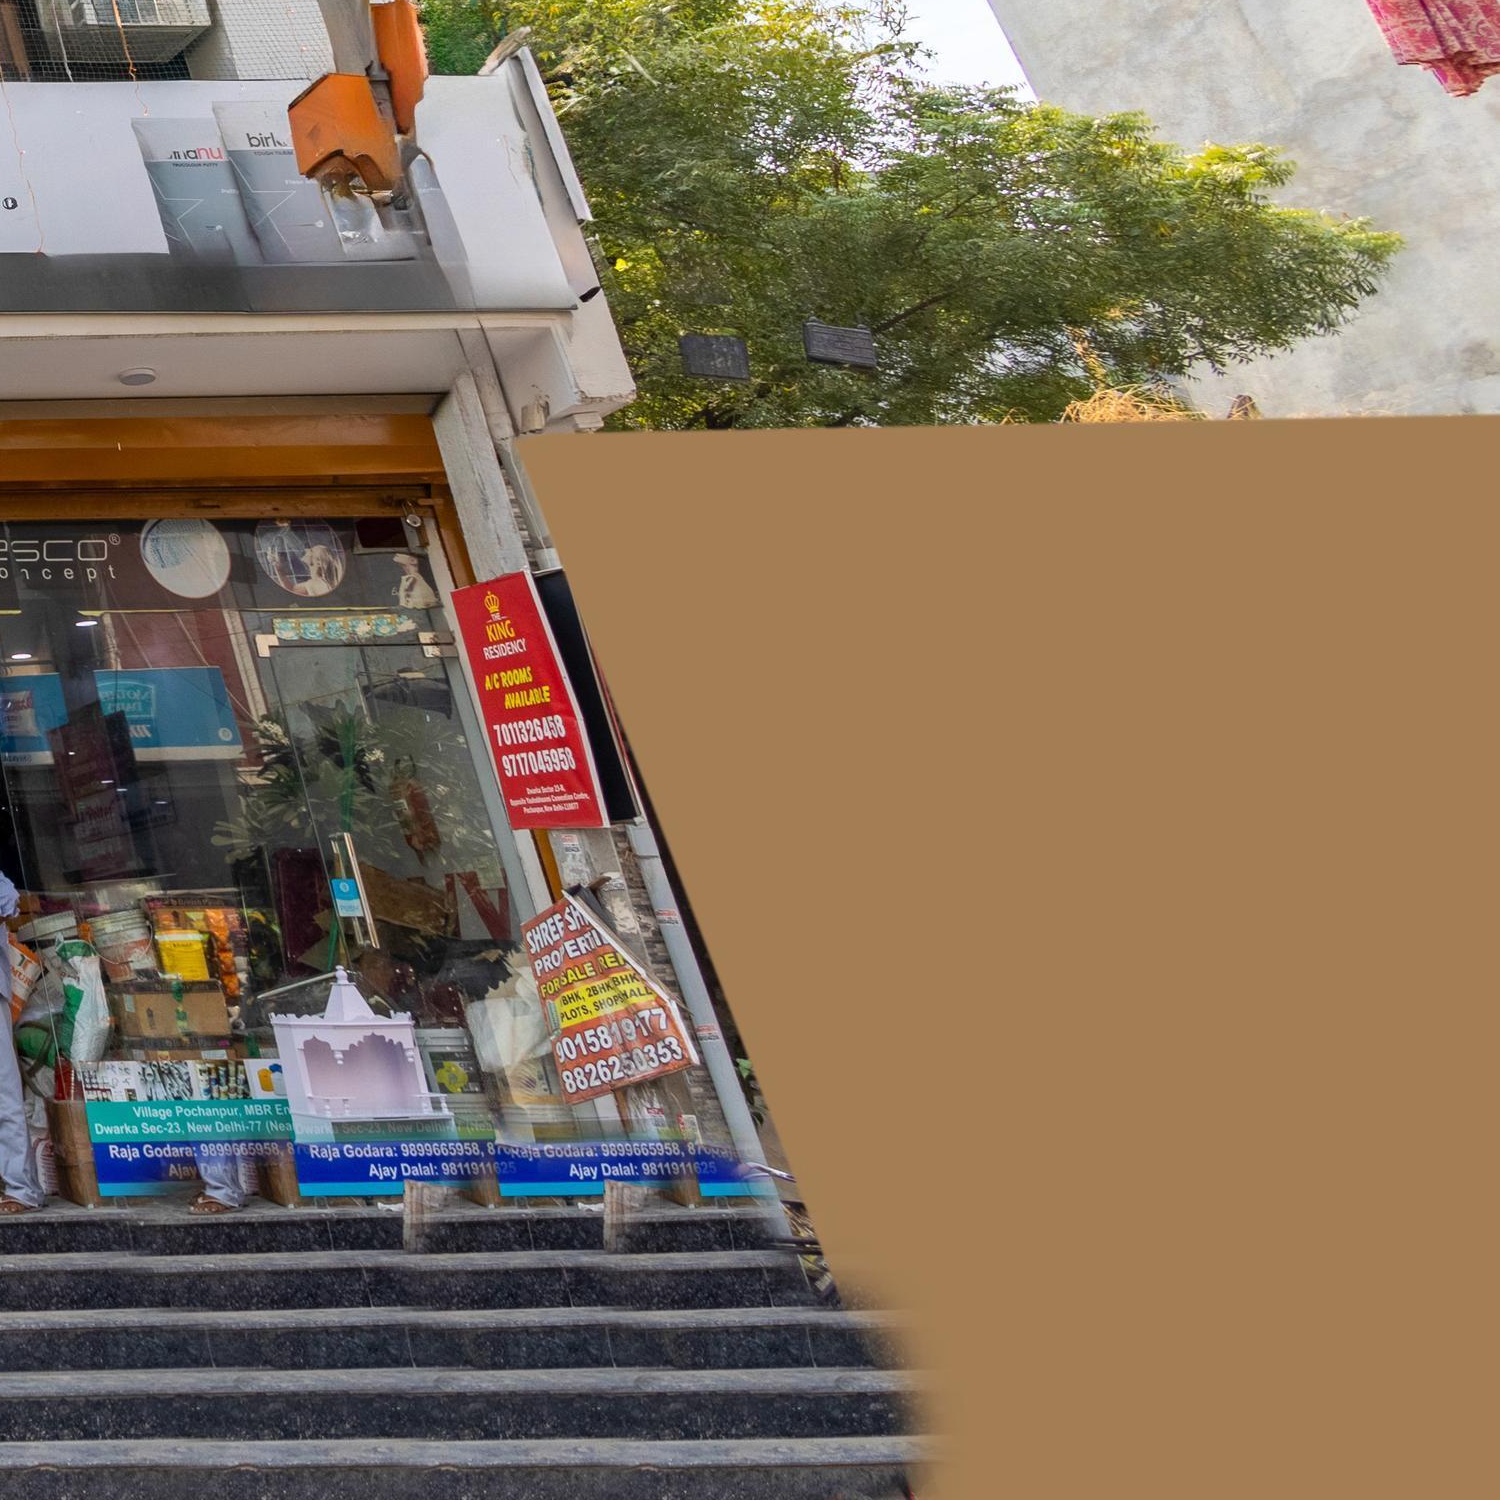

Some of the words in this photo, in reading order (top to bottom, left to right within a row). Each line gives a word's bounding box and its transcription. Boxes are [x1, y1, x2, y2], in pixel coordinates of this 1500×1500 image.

[246, 132, 288, 147] birl
[486, 620, 516, 642] KING
[483, 638, 527, 660] RESIDENCY
[485, 673, 500, 691] A/C
[500, 666, 533, 688] ROOMS
[505, 685, 551, 709] AVAILABLE
[493, 714, 566, 747] 7011326458
[501, 747, 576, 778] 9717045958
[525, 913, 564, 955] SHREE
[540, 979, 561, 998] FOR
[560, 961, 597, 986] SALE
[561, 1005, 593, 1022] PLOTS,
[132, 1106, 172, 1120] Village
[176, 1106, 242, 1120] Pochanpur,
[244, 1105, 273, 1116] MBR
[94, 1123, 138, 1135] Dwarka
[142, 1122, 185, 1135] Sec-23,
[187, 1123, 212, 1134] New
[215, 1121, 262, 1133] Delhi-77
[108, 1144, 141, 1161] Raja
[143, 1143, 197, 1158] Godara:
[310, 1144, 341, 1162] Raja
[343, 1143, 399, 1159] Godara:
[402, 1142, 485, 1158] 9899665958,
[544, 1143, 599, 1159] Godara:
[602, 1142, 686, 1158] 9899665958,
[168, 1163, 197, 1179] Ajay
[369, 1163, 398, 1180] Ajay
[401, 1162, 439, 1177] Dalal:
[569, 1163, 598, 1180] Ajay
[601, 1161, 639, 1177] Dalal:
